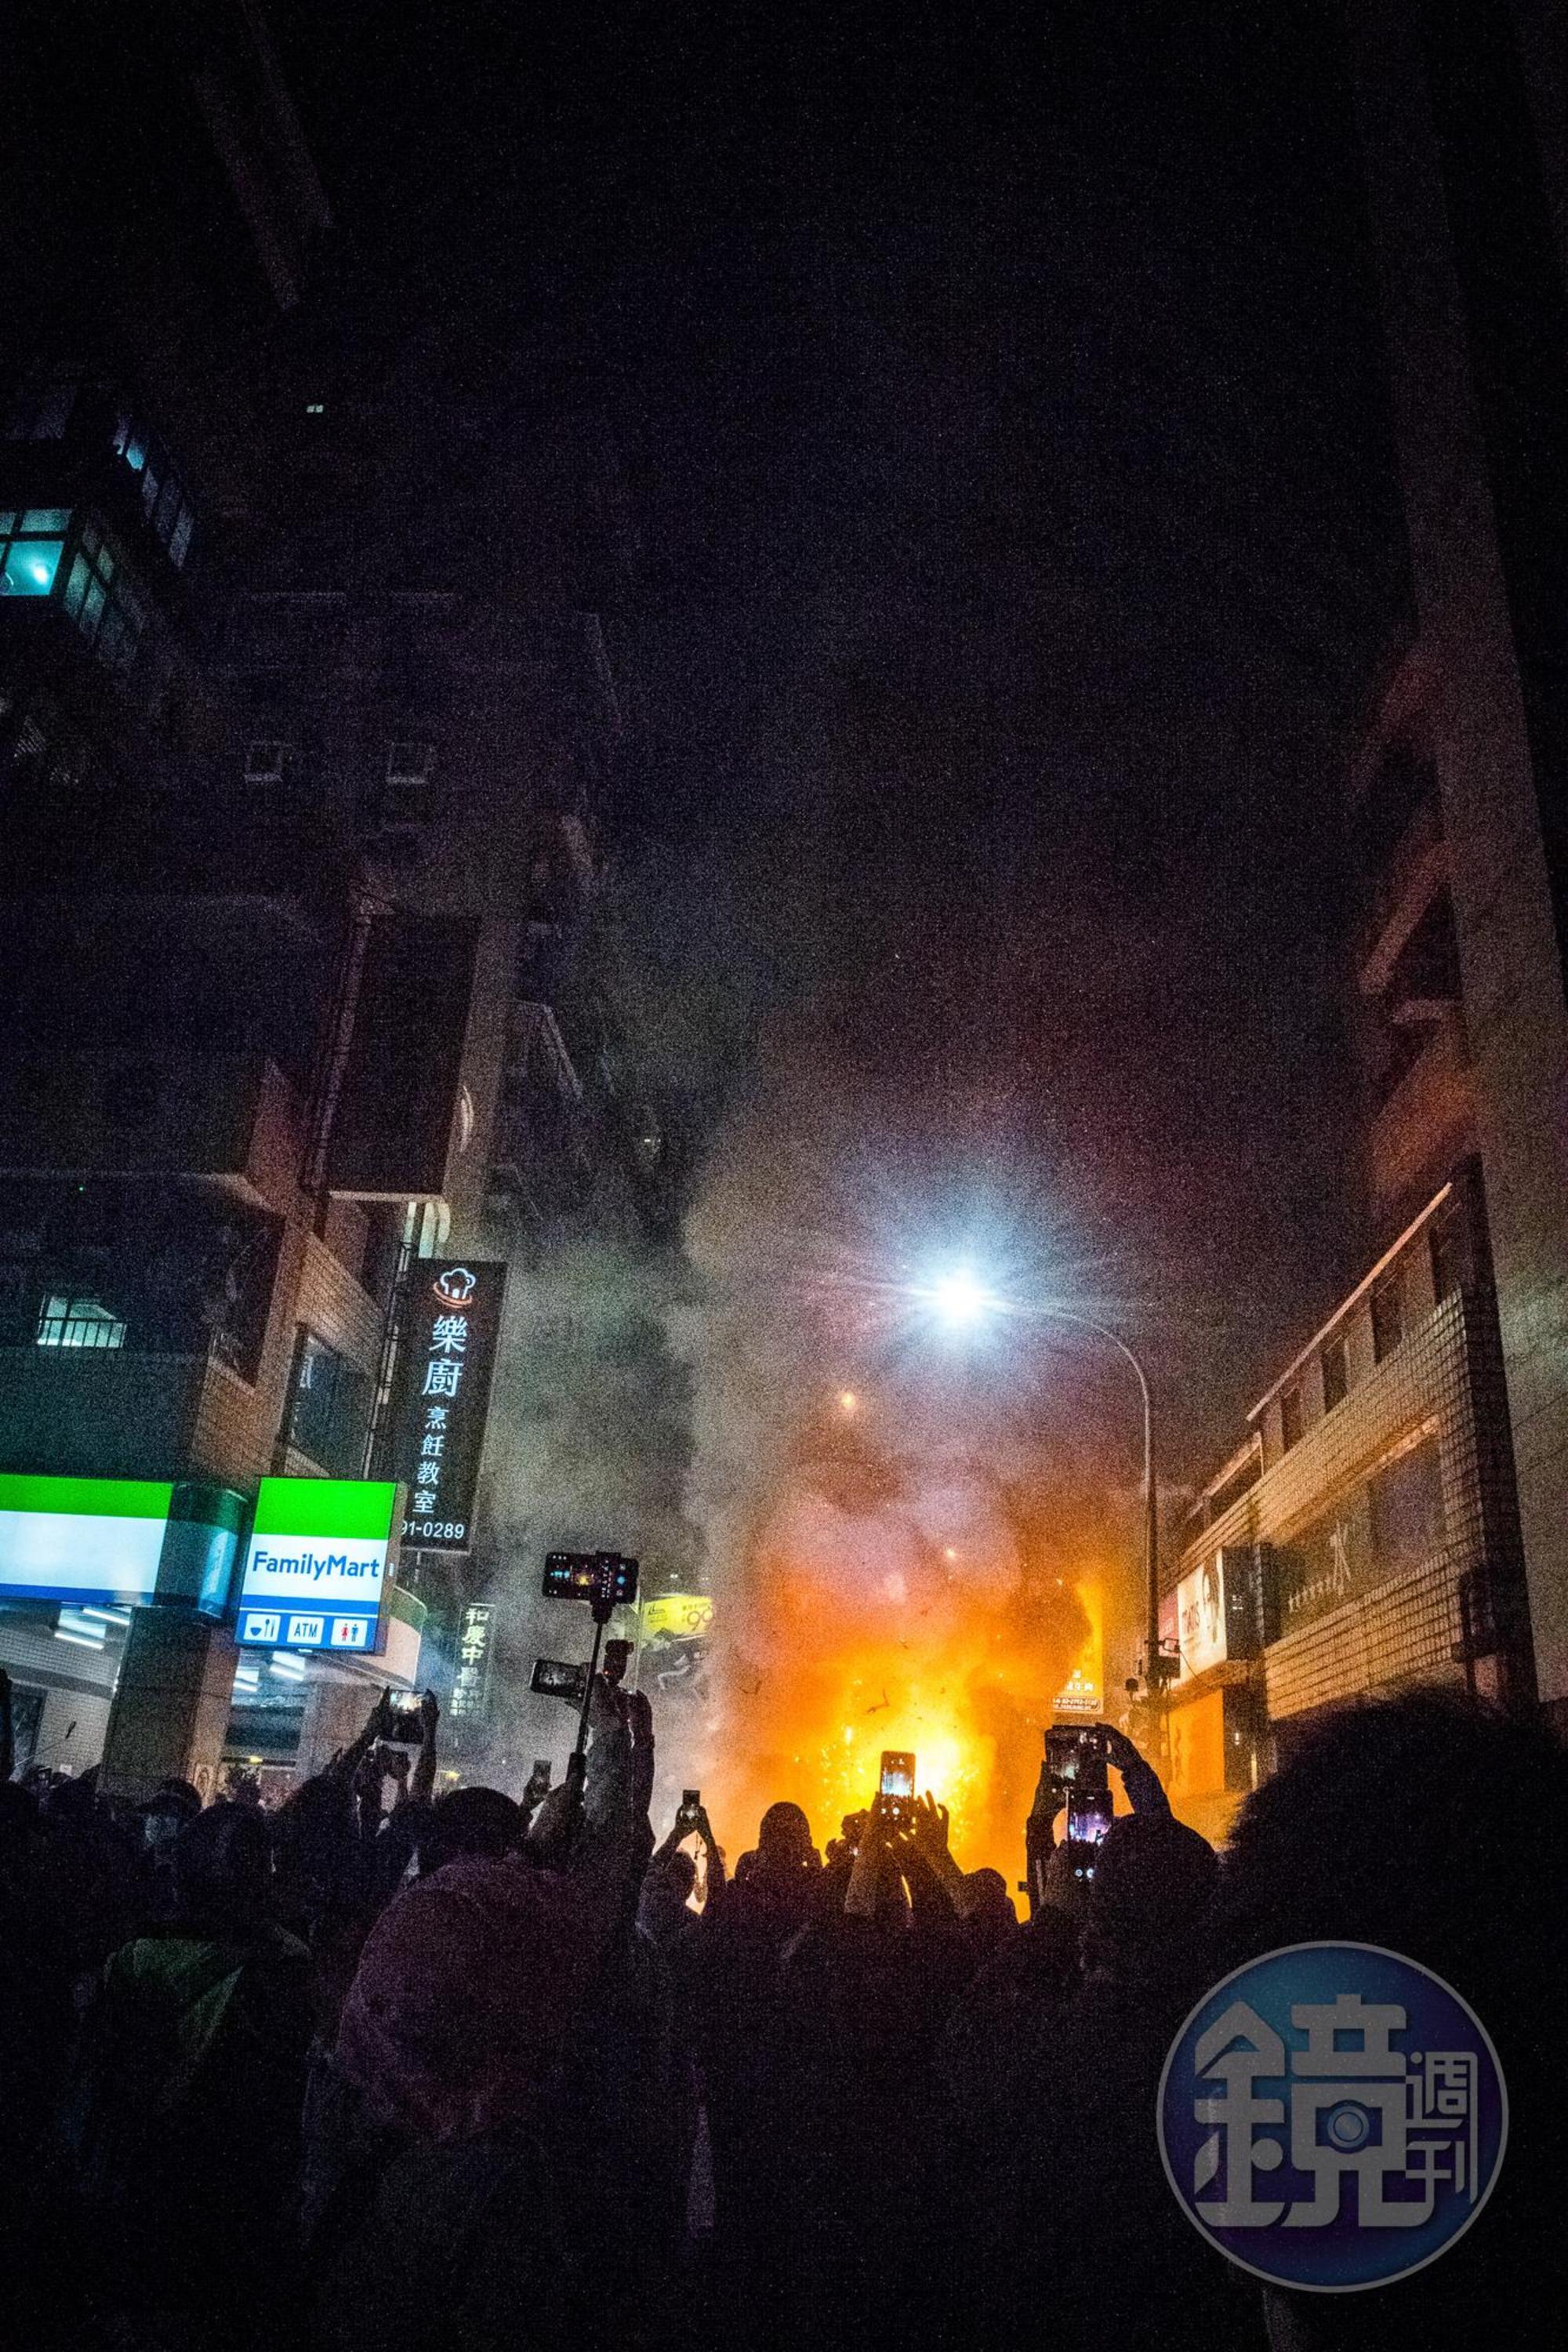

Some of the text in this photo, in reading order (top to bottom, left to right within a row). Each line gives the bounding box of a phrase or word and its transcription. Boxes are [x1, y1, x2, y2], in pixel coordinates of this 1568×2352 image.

[412, 1314, 468, 1514] 樂廚 烹飪教室
[252, 1551, 380, 1581] FamilyMart
[293, 1622, 318, 1638] ATM
